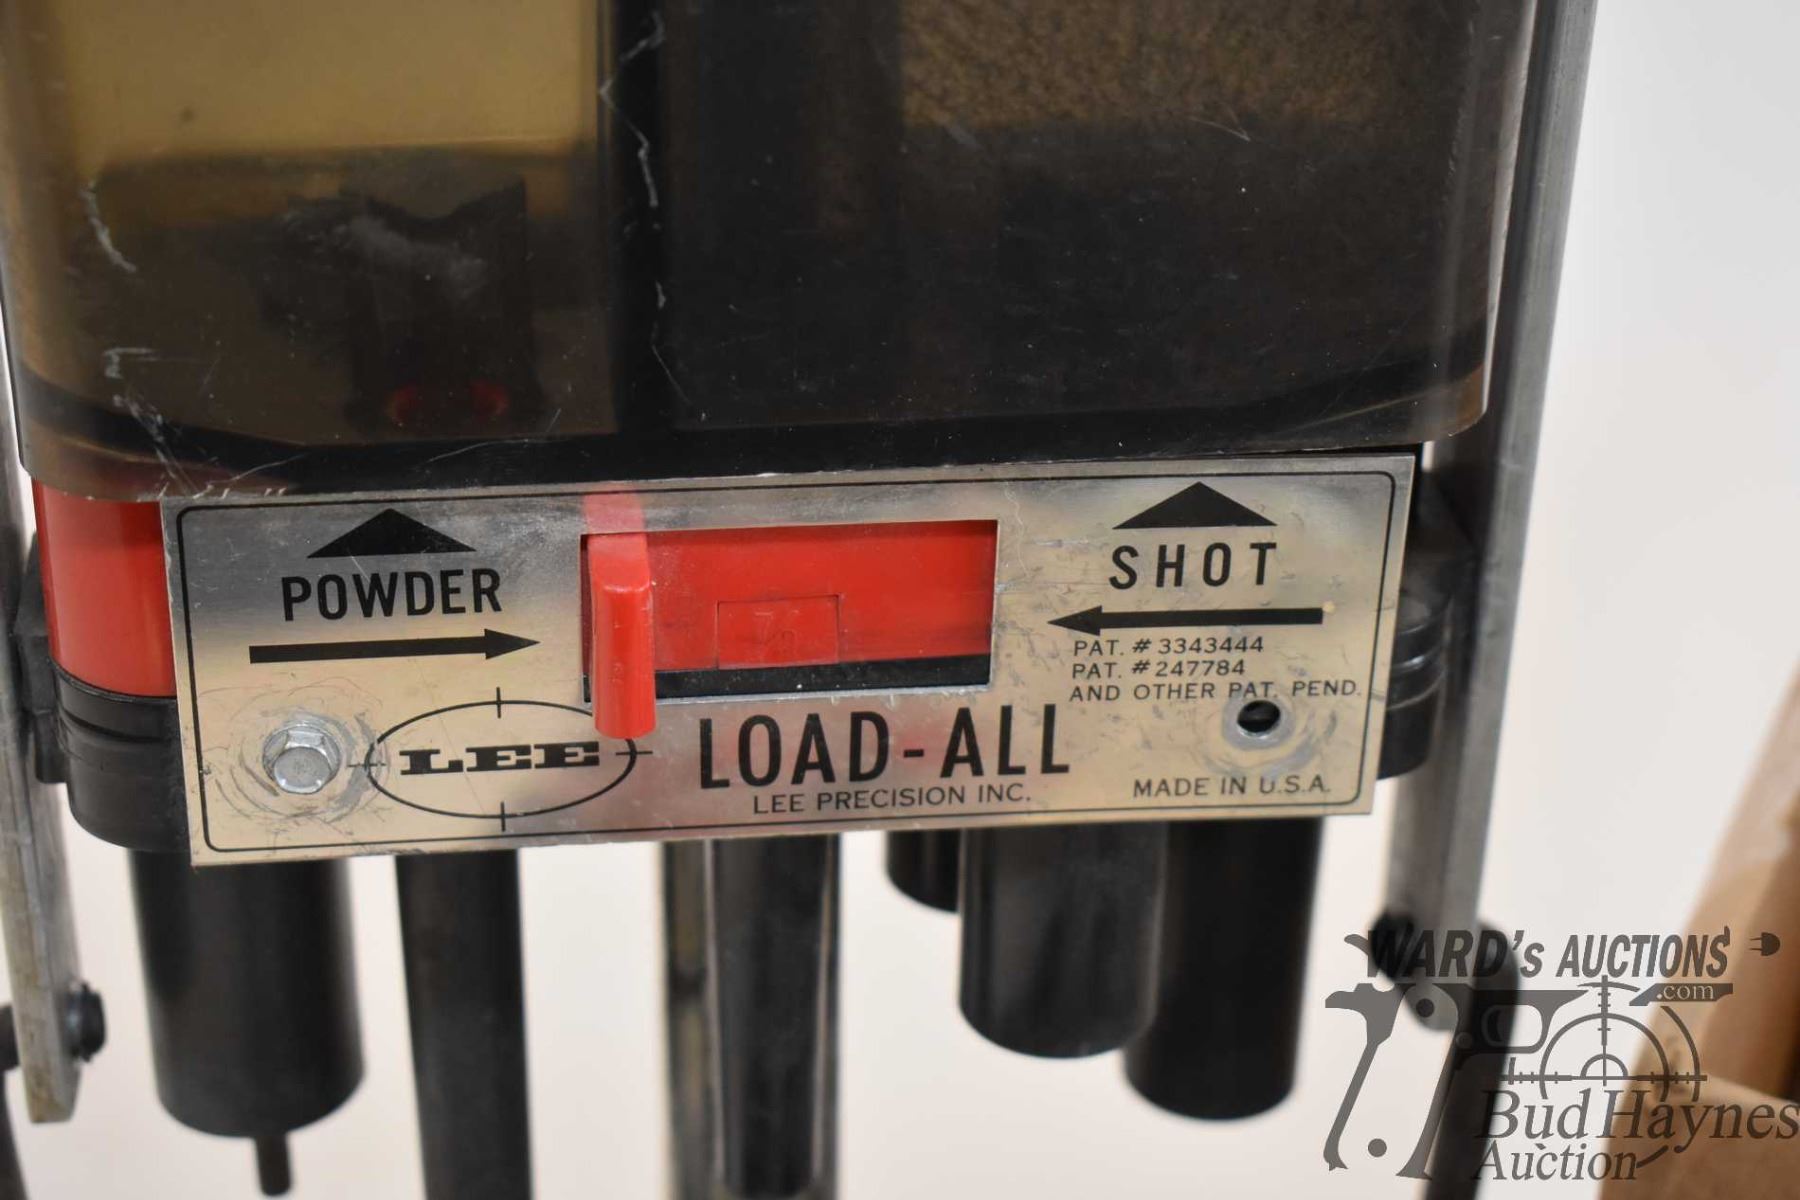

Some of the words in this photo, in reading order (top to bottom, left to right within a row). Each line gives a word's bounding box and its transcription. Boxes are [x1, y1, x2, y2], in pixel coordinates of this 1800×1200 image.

[1108, 541, 1277, 590] SHOT
[281, 567, 502, 621] POWDER
[1073, 639, 1125, 656] PAT.
[1072, 662, 1122, 679] PAT.
[1069, 685, 1121, 702] AND
[1133, 682, 1215, 700] OTHER
[1228, 681, 1278, 699] PAT.
[1292, 679, 1361, 697] PEND.
[399, 741, 600, 776] LEE
[699, 703, 1070, 789] LOAD-ALL
[753, 794, 805, 815] LEE
[816, 785, 966, 811] PRECISION
[978, 782, 1032, 802] INC.
[1132, 778, 1210, 799] MADE
[1219, 777, 1247, 796] IN
